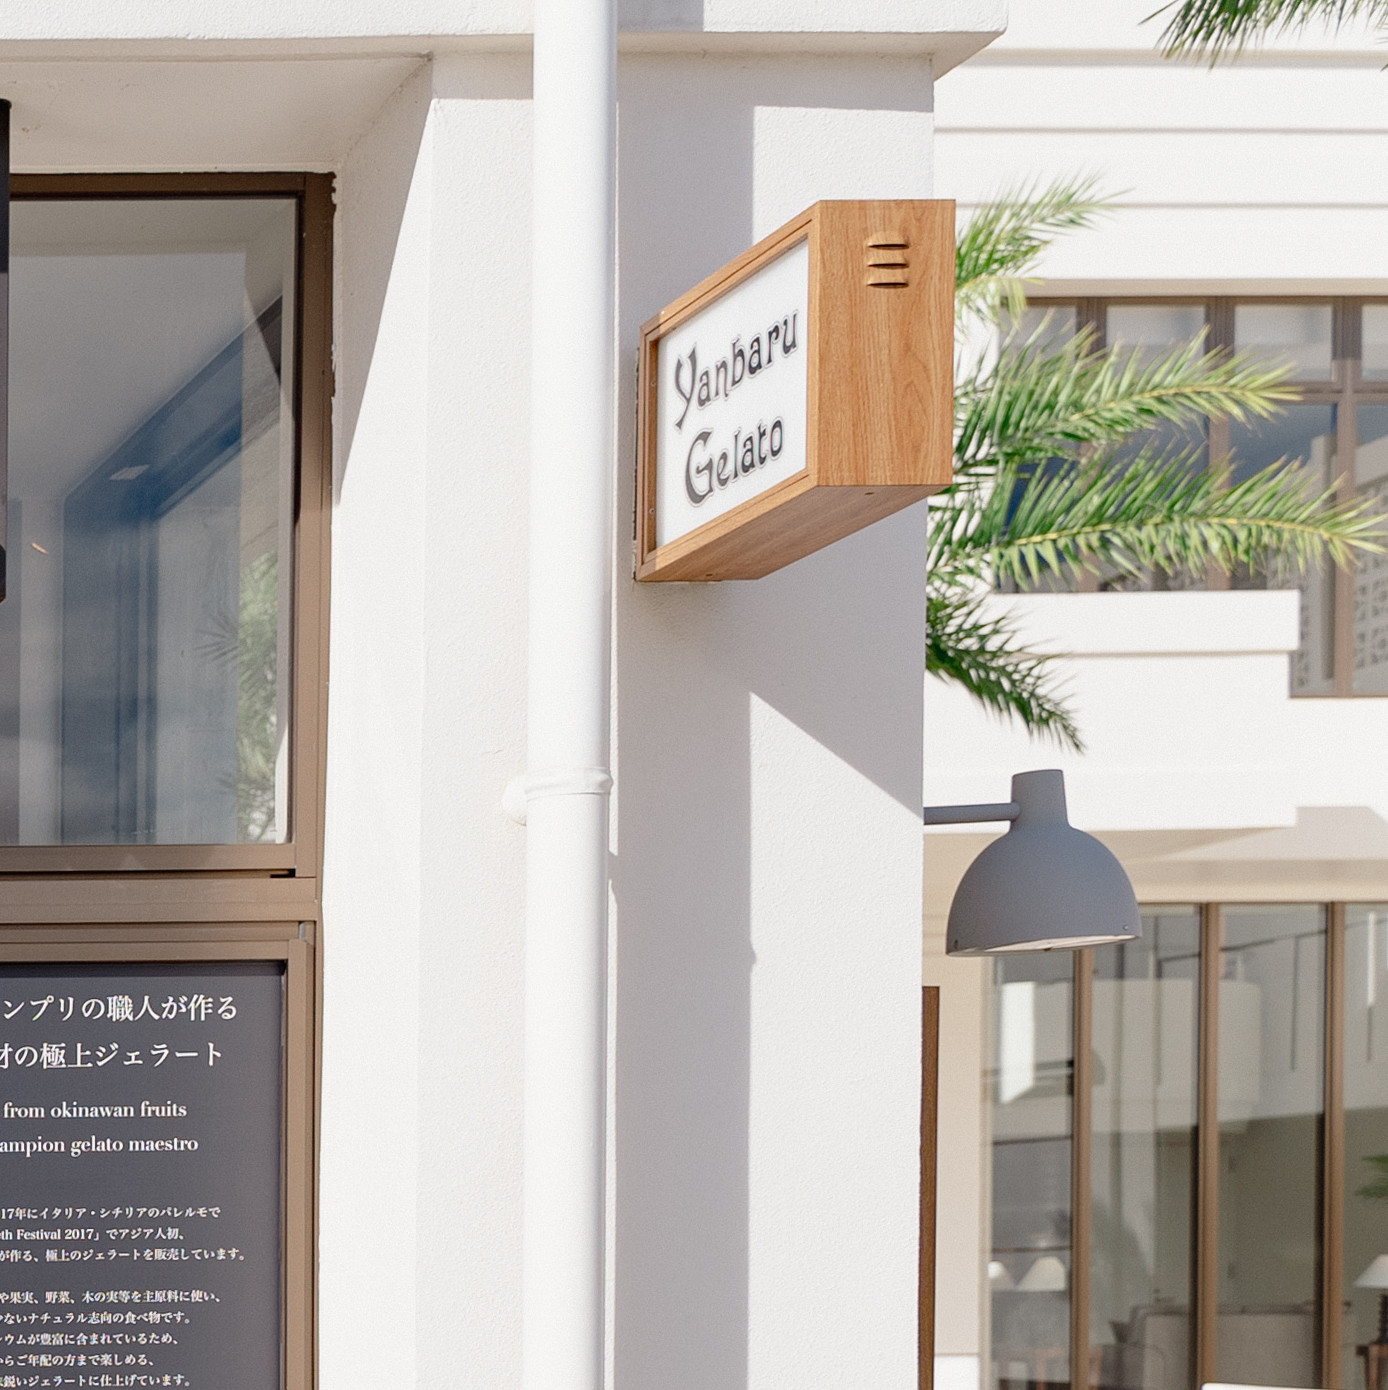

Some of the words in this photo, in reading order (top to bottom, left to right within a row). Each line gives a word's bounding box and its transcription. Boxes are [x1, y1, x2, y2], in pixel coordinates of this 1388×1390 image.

[674, 310, 801, 431] Yanbaru
[684, 415, 785, 506] Gelato
[3, 1102, 45, 1119] from
[50, 1102, 135, 1119] okinawan
[140, 1101, 187, 1118] fruits
[71, 1136, 123, 1158] gelato
[128, 1138, 199, 1153] maestro
[17, 1228, 61, 1241] Festival
